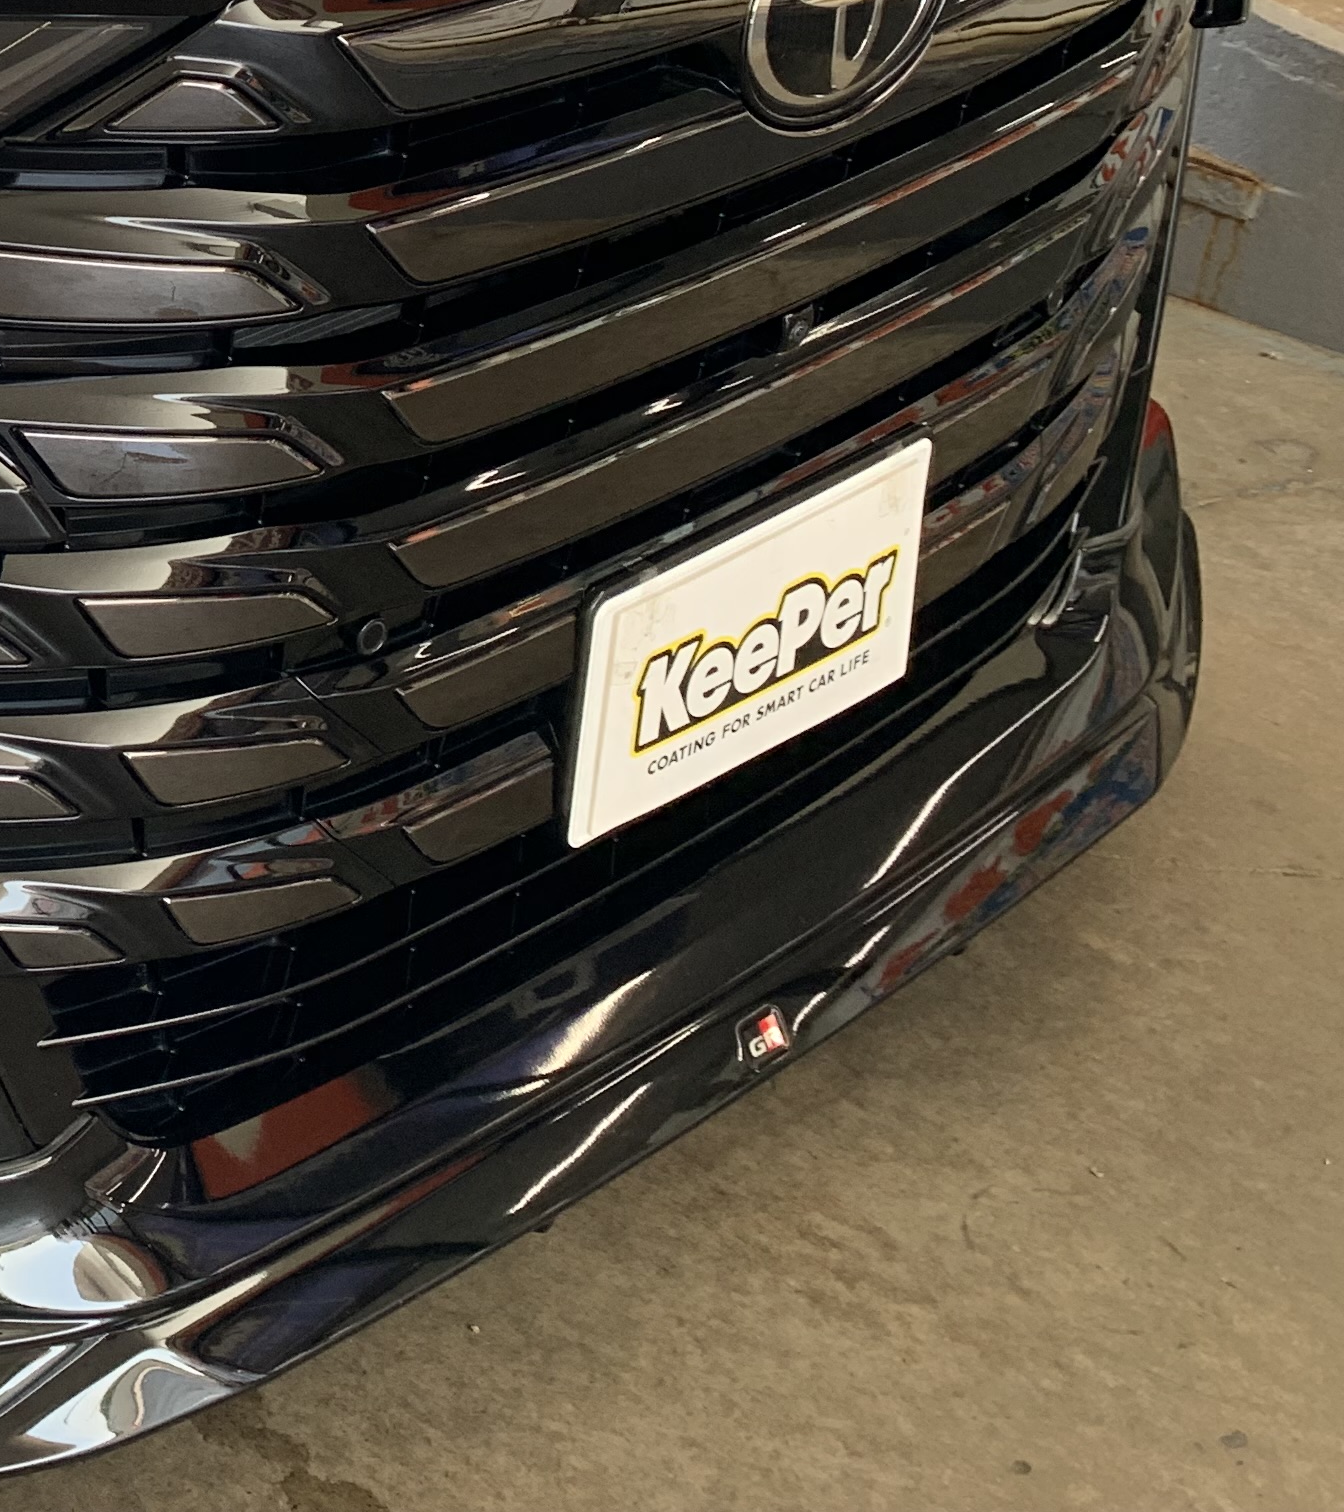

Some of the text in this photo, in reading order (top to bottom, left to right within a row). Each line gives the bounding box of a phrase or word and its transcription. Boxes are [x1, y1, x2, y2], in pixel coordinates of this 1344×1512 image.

[633, 547, 899, 754] KeePer
[647, 648, 871, 775] COATING FOR SMART CAR LIFE
